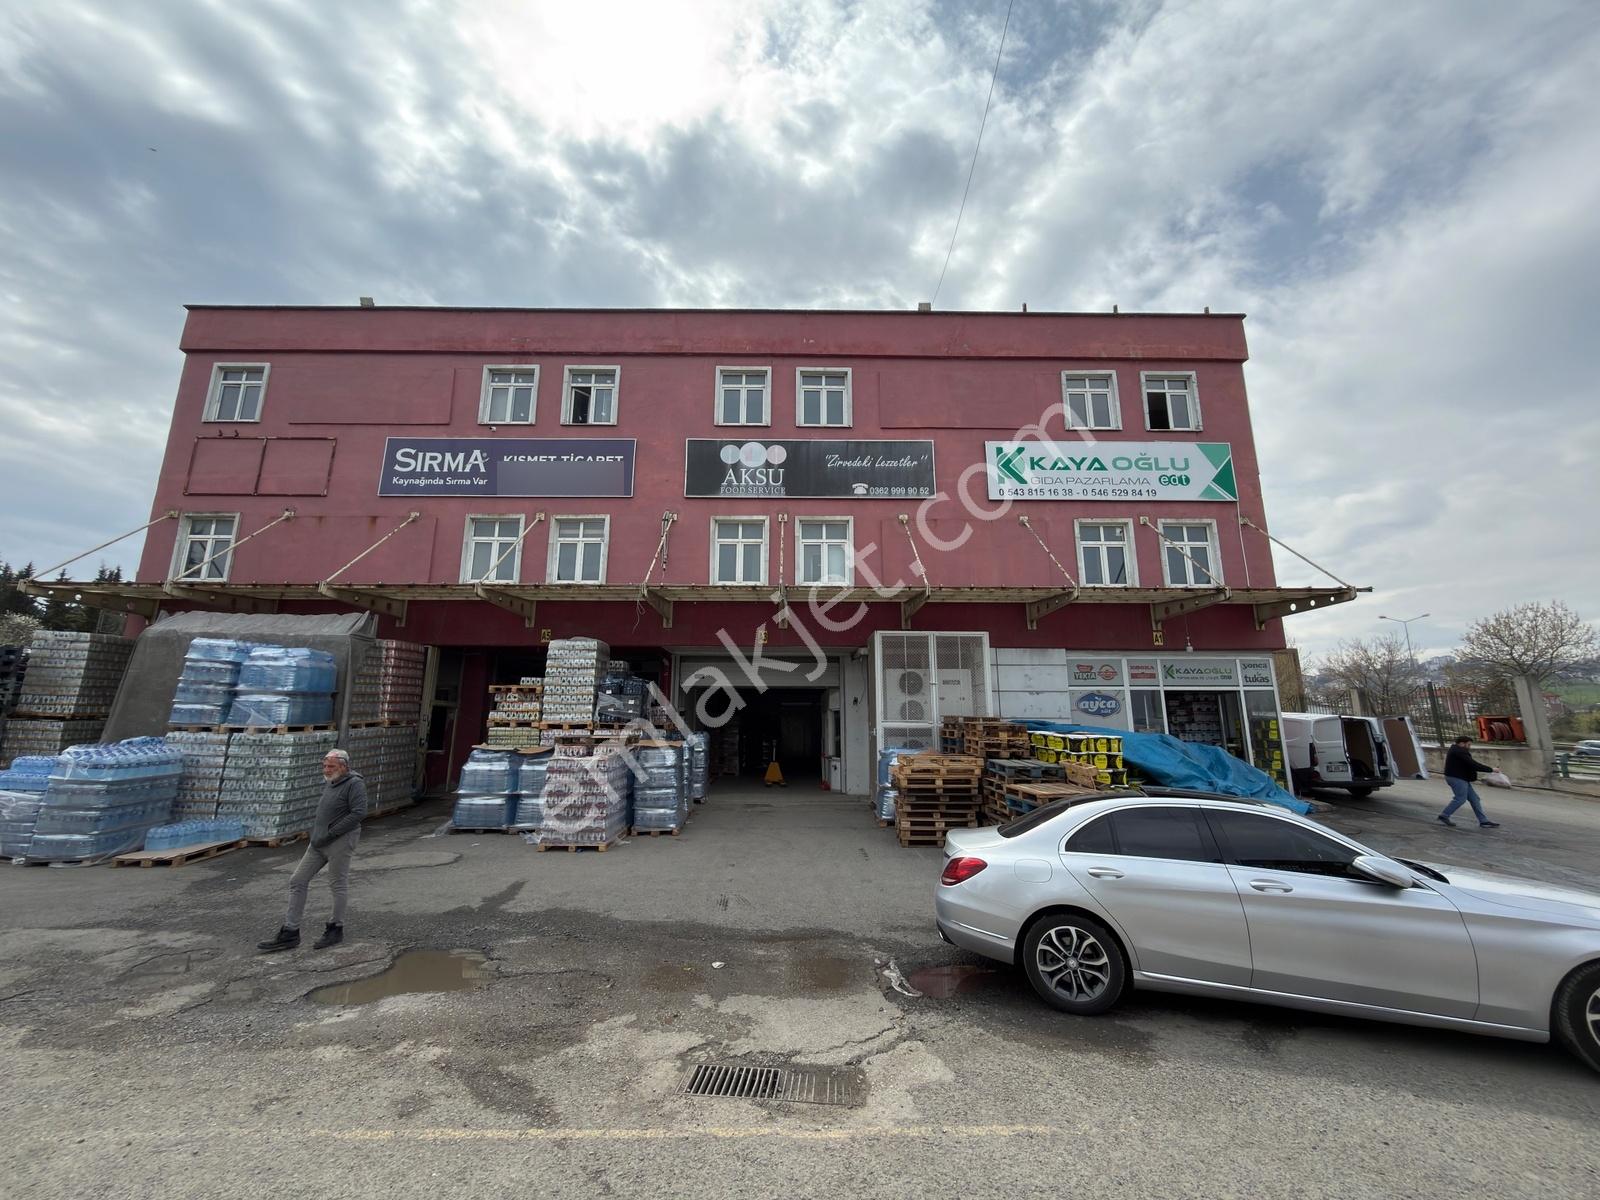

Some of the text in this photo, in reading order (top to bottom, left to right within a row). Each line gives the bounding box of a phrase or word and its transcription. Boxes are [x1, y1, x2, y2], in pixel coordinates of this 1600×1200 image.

[393, 448, 489, 472] SIRMA
[1030, 452, 1190, 471] KAYA OĞLU
[392, 476, 488, 487] Kaynağında Sırma Var
[721, 468, 785, 486] AKSU
[1030, 477, 1151, 486] GIDA PAZARLAMA
[720, 486, 786, 494] FOOD SERVICE
[890, 486, 906, 495] 999
[907, 486, 918, 495] 90
[999, 488, 1005, 497] 0
[1008, 488, 1025, 497] 543
[1028, 488, 1045, 497] 815
[1048, 488, 1059, 497] 16
[1062, 488, 1073, 497] 38
[1082, 488, 1088, 497] 0
[1091, 488, 1109, 497] 546
[1112, 488, 1129, 497] 529
[1131, 488, 1143, 497] 84
[1146, 488, 1157, 497] 19
